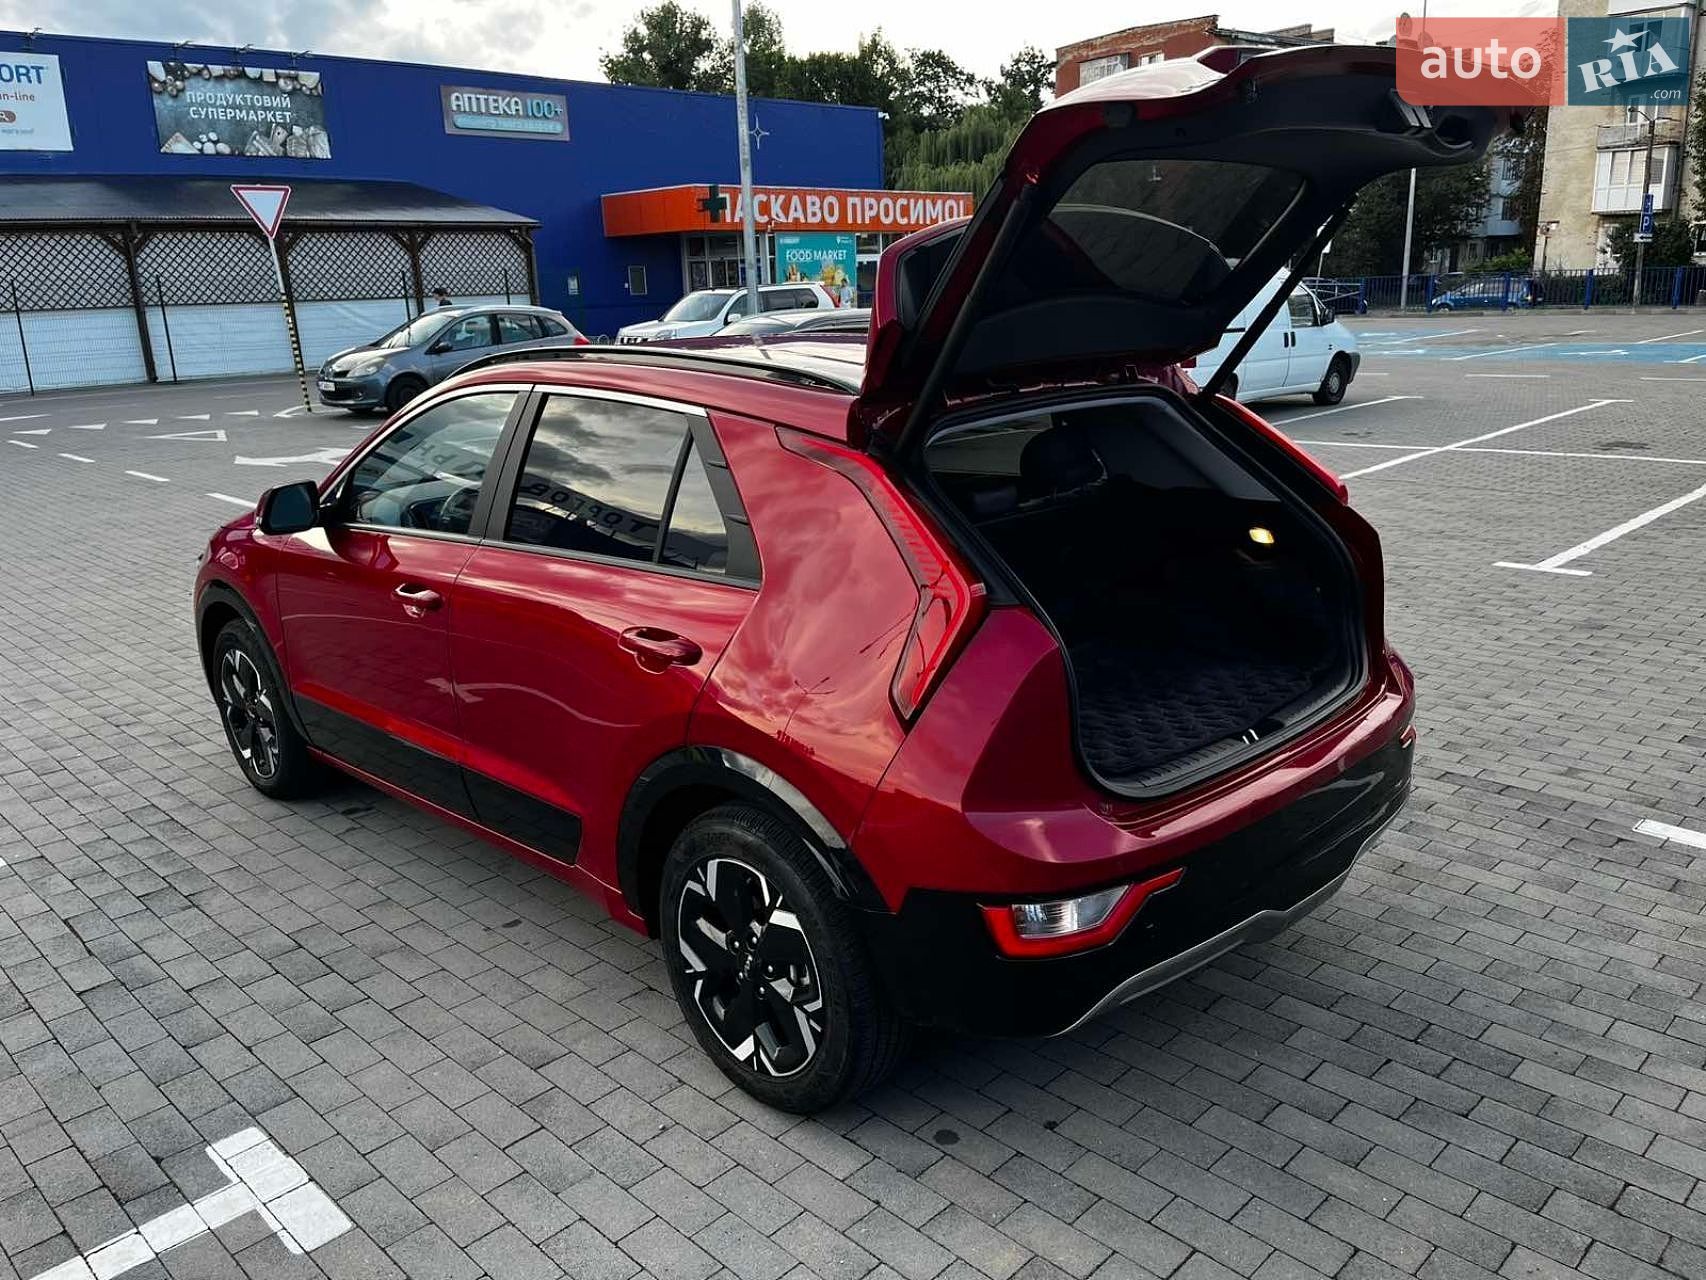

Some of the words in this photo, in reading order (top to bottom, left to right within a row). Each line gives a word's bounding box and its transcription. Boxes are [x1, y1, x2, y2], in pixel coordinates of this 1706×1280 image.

[0, 91, 35, 102] n-line
[186, 91, 291, 108] ПРОДУКТОВИЙ
[450, 92, 523, 115] АПТЕКА
[526, 98, 564, 118] 100+
[189, 107, 292, 123] СУПЕРМАРКЕТ
[786, 249, 812, 262] FOOD
[813, 249, 847, 261] MARKET
